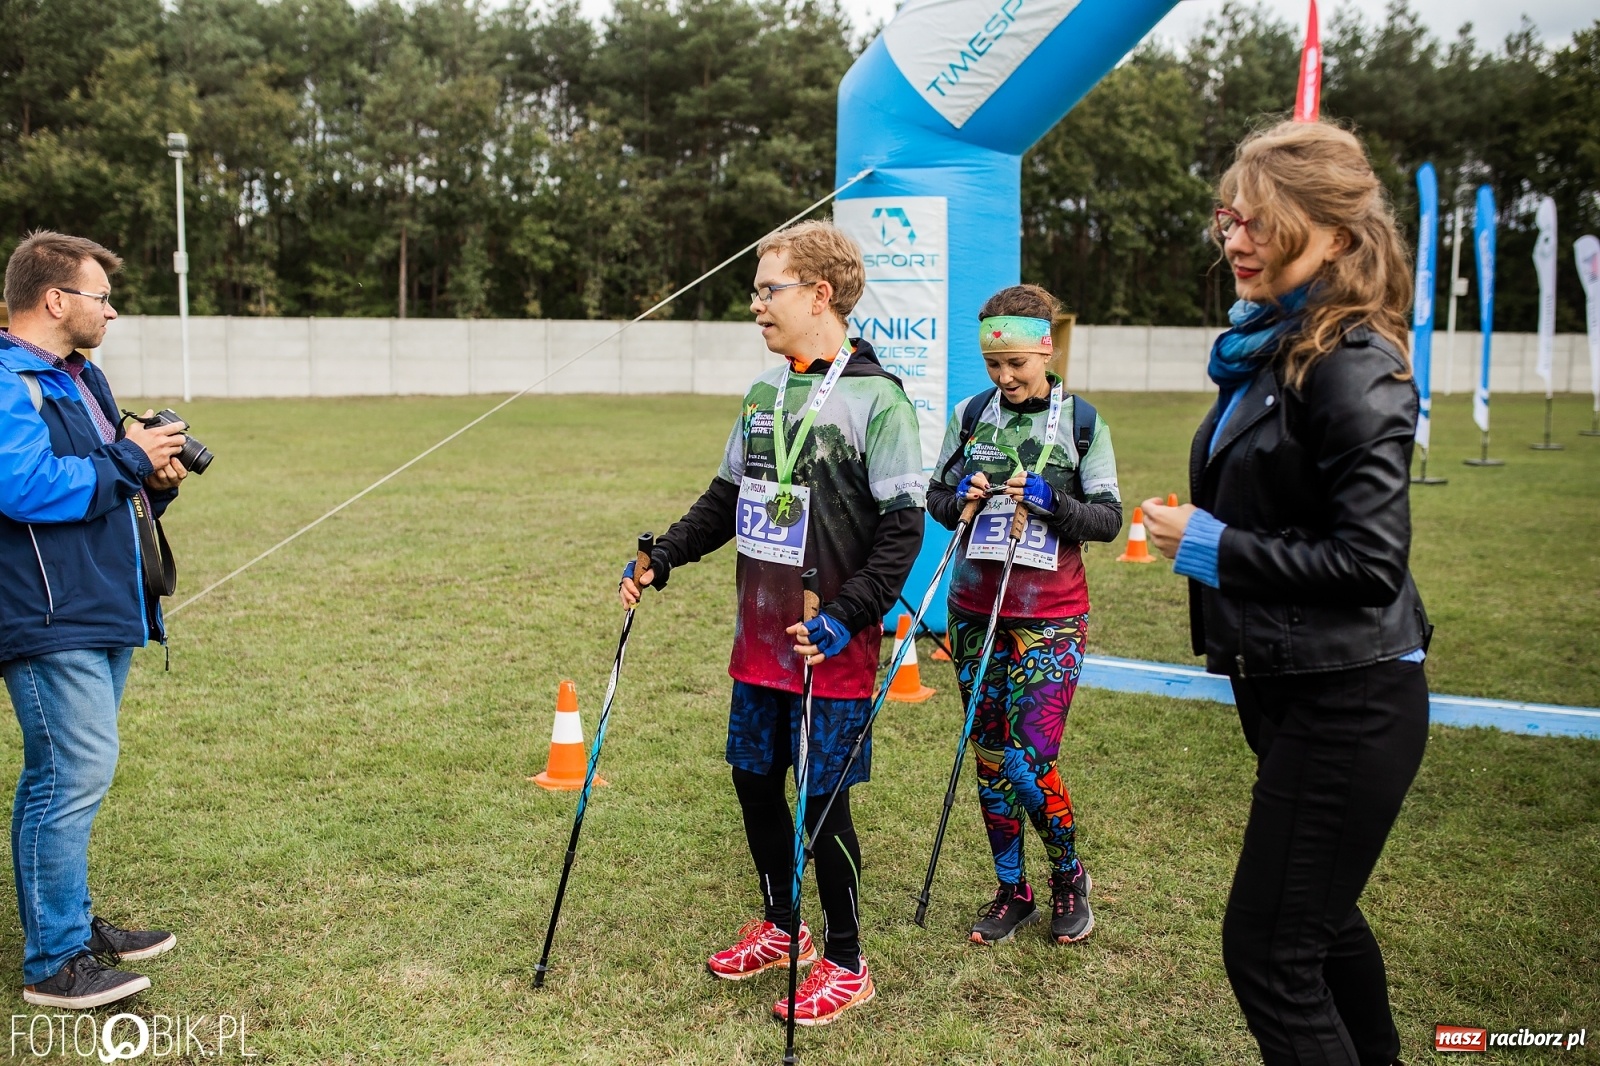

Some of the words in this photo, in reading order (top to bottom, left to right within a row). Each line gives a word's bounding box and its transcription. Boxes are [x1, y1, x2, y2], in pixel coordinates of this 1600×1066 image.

[926, 0, 1035, 97] TIMESP
[847, 317, 936, 340] YNIKI
[132, 493, 144, 518] ikon
[741, 503, 789, 542] 325
